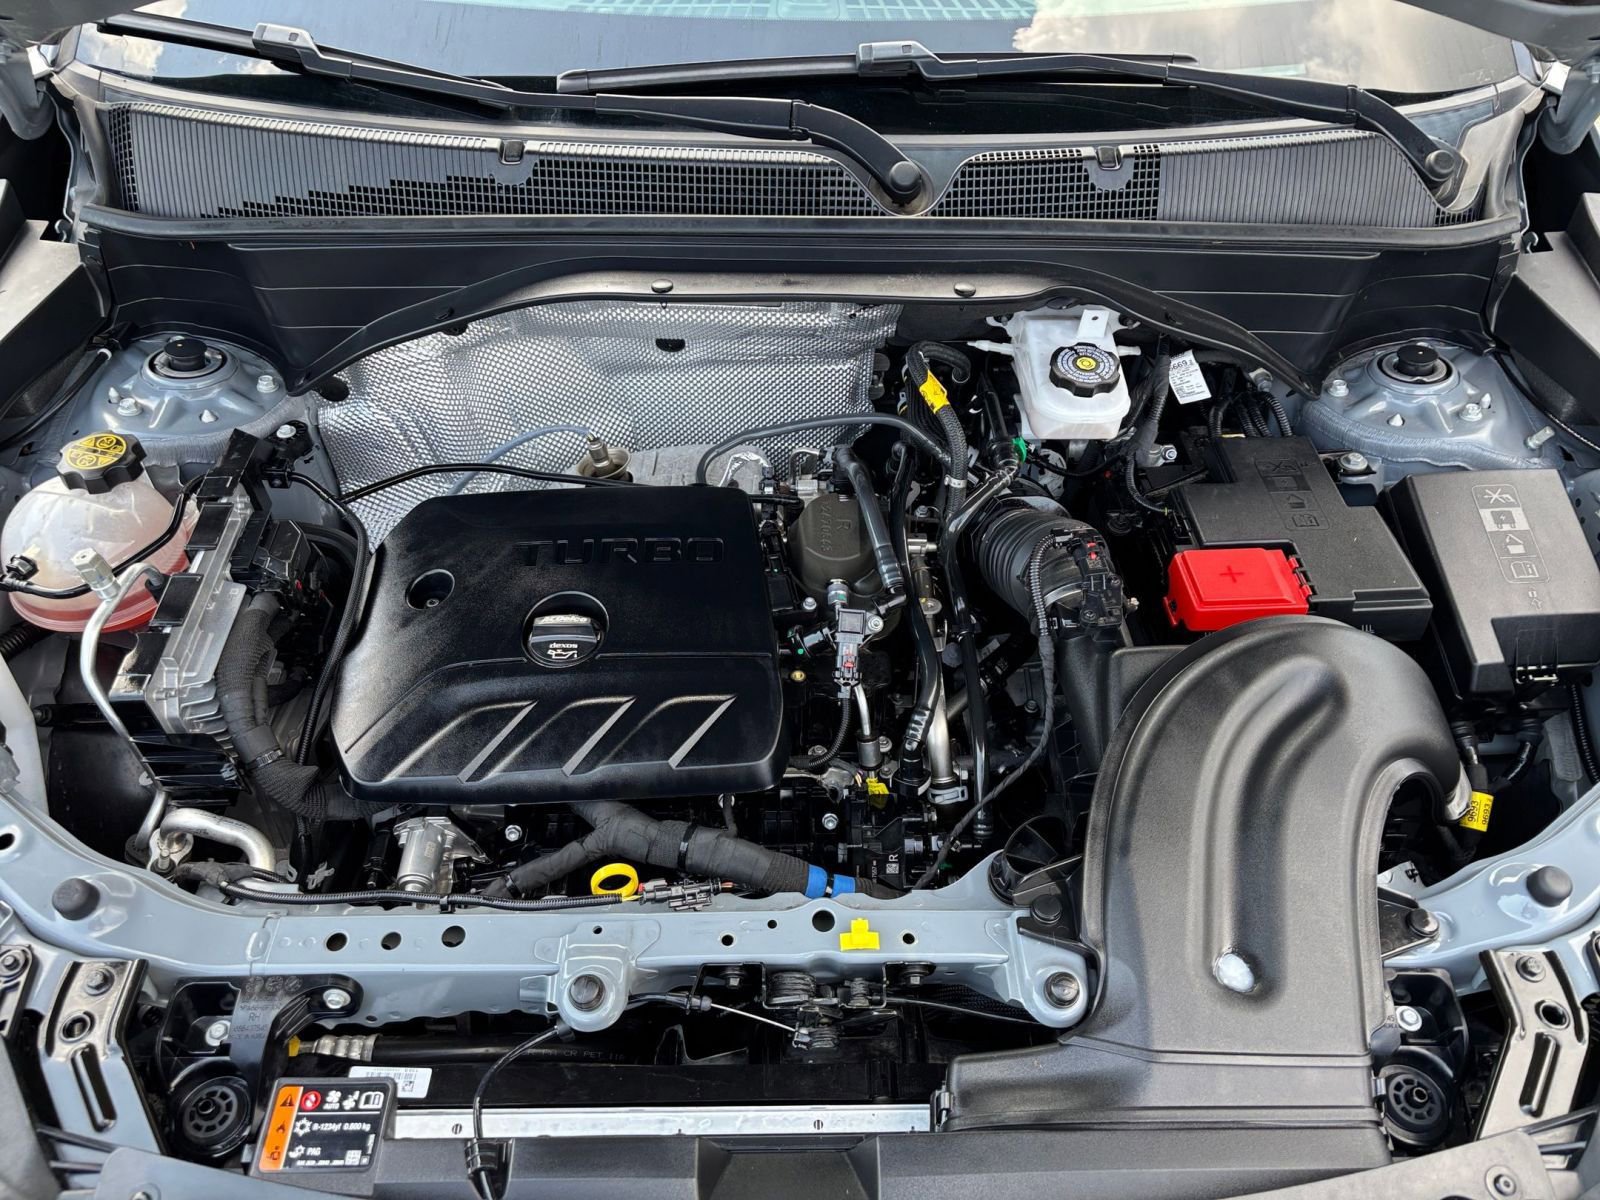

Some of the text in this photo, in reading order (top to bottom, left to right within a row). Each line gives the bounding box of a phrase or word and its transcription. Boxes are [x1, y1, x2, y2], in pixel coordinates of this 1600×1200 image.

[514, 537, 724, 567] TURBO
[889, 854, 898, 862] R
[306, 1147, 321, 1156] PAG
